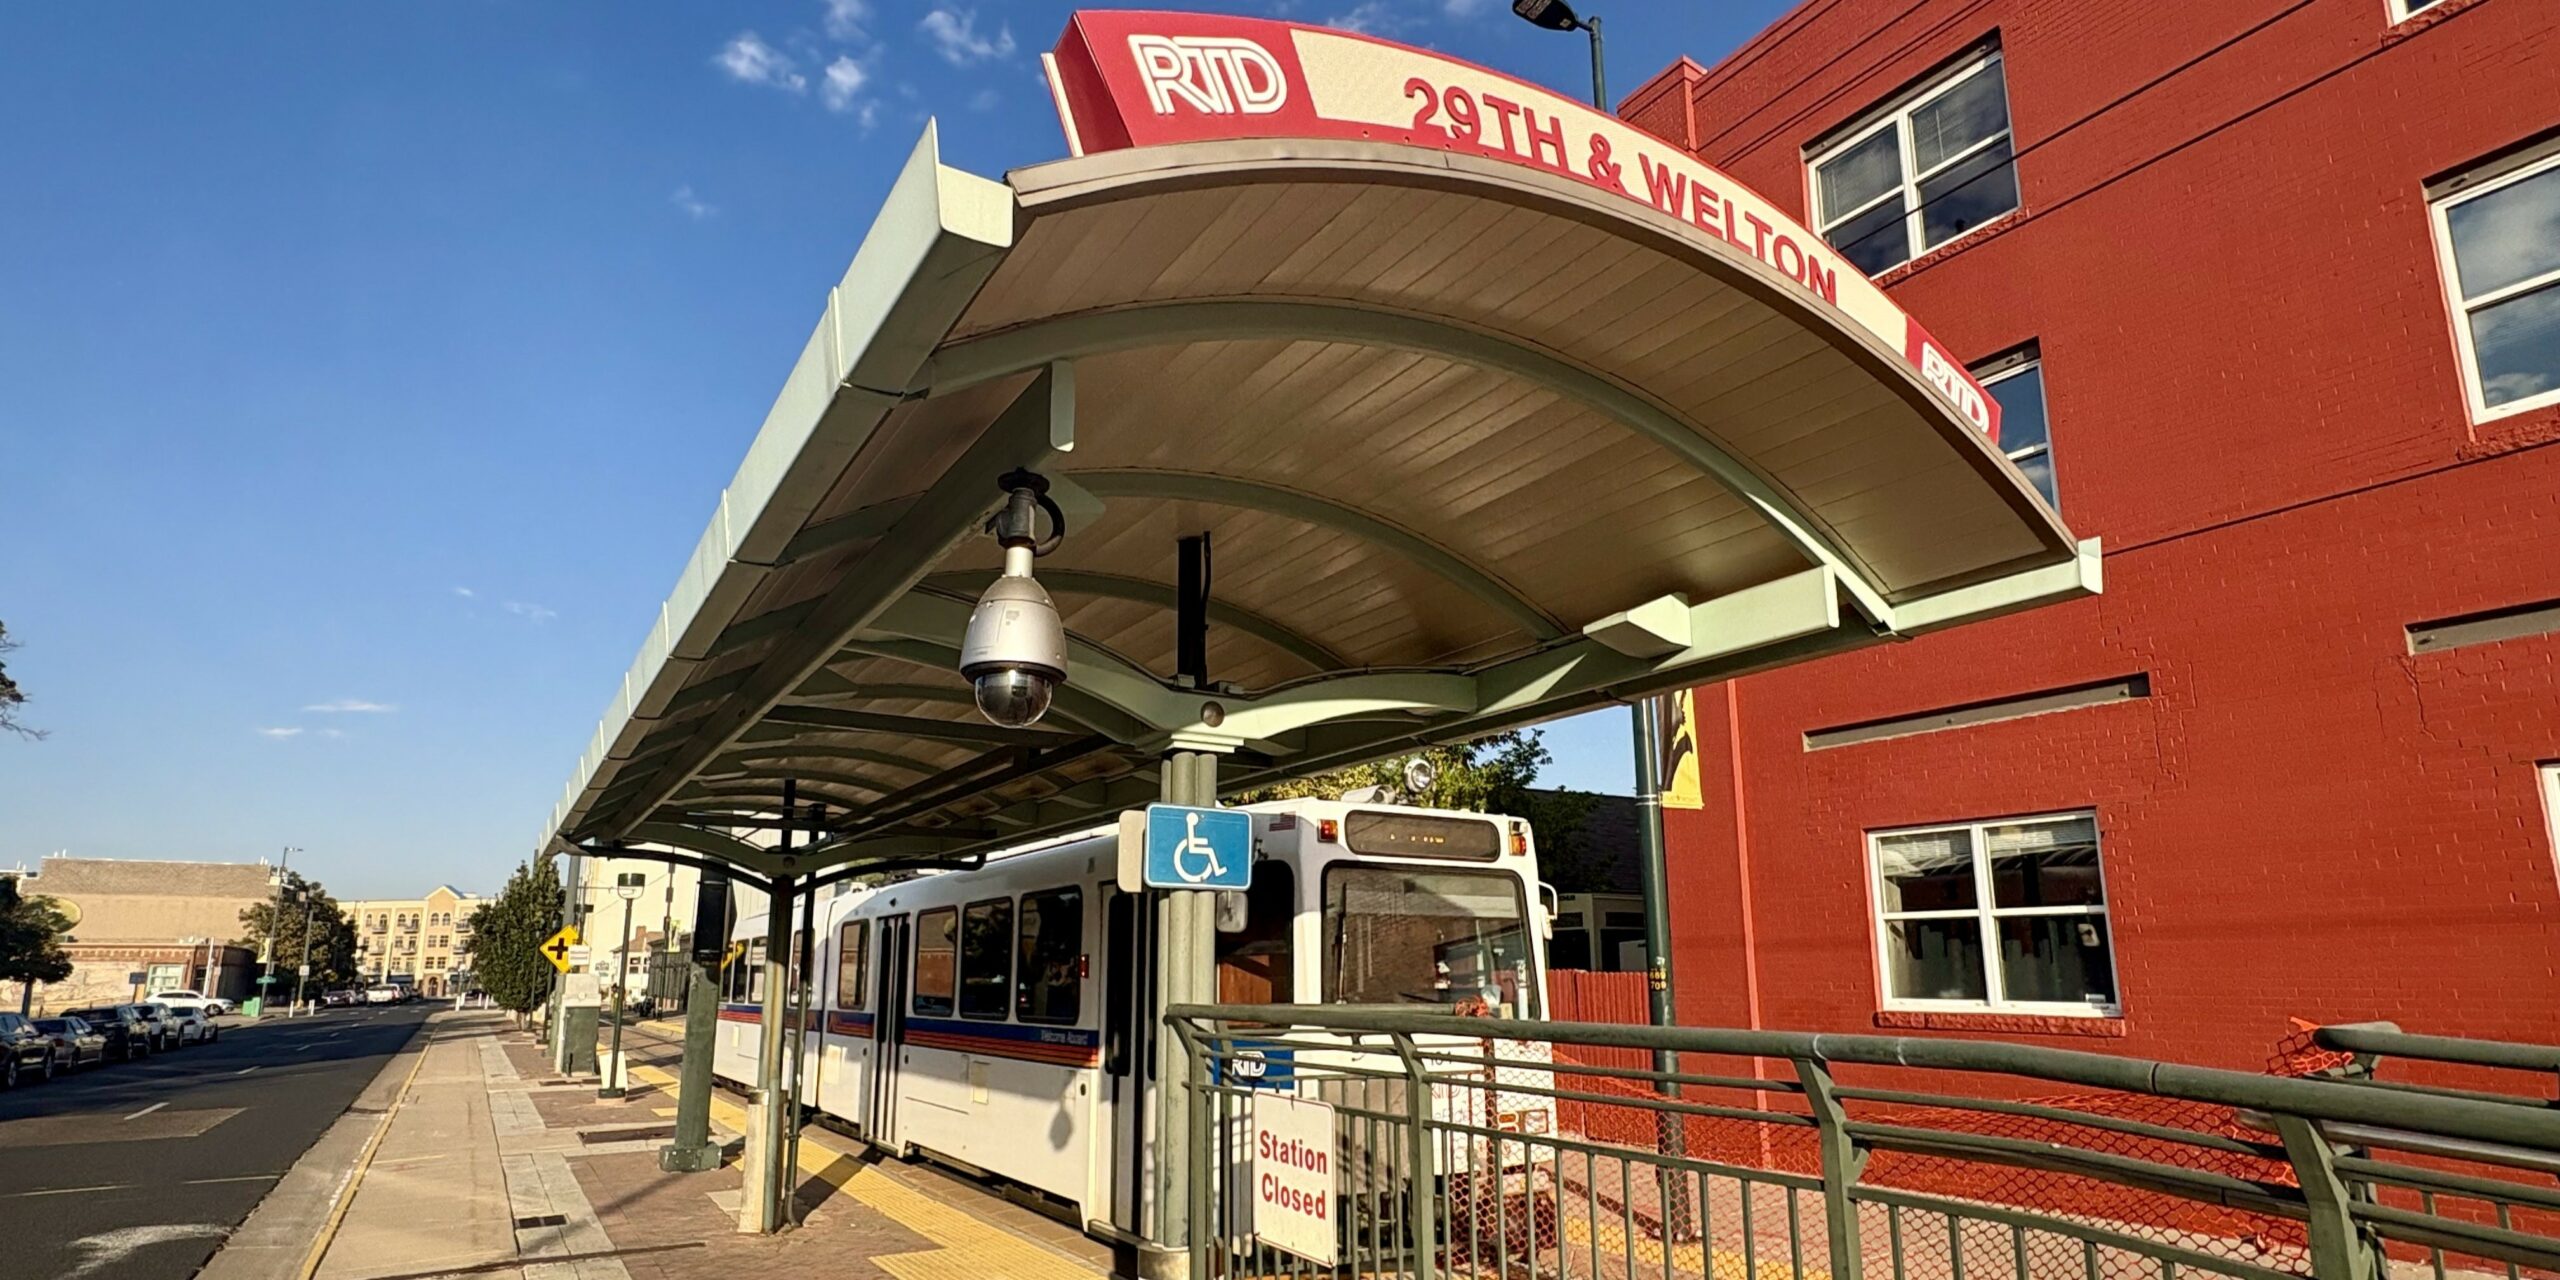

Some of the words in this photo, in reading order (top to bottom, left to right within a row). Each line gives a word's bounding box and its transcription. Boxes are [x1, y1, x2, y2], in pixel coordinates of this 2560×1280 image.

[1127, 34, 1288, 116] RTD
[1404, 77, 1569, 172] 29TH
[1588, 132, 1626, 196] &
[1638, 152, 1836, 307] WELTON
[1922, 341, 1990, 433] RTD
[1259, 1129, 1327, 1174] Station
[1261, 1172, 1326, 1221] Closed
